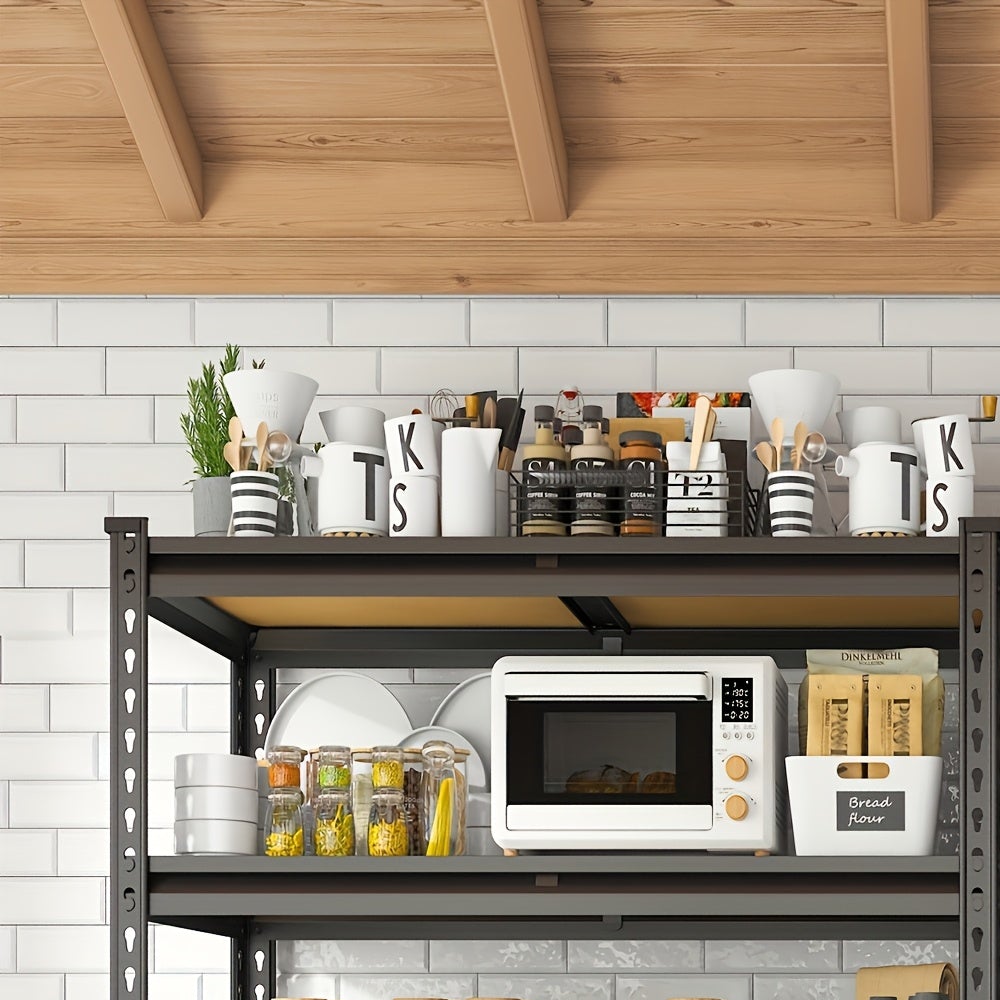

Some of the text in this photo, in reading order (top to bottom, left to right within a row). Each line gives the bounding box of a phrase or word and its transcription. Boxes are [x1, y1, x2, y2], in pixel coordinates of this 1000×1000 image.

[398, 422, 424, 472] K
[939, 421, 965, 473] K
[353, 452, 385, 521] T
[392, 483, 408, 532] S
[890, 452, 918, 521] T
[931, 482, 949, 533] S
[847, 811, 886, 827] flour
[849, 796, 893, 809] Bread
